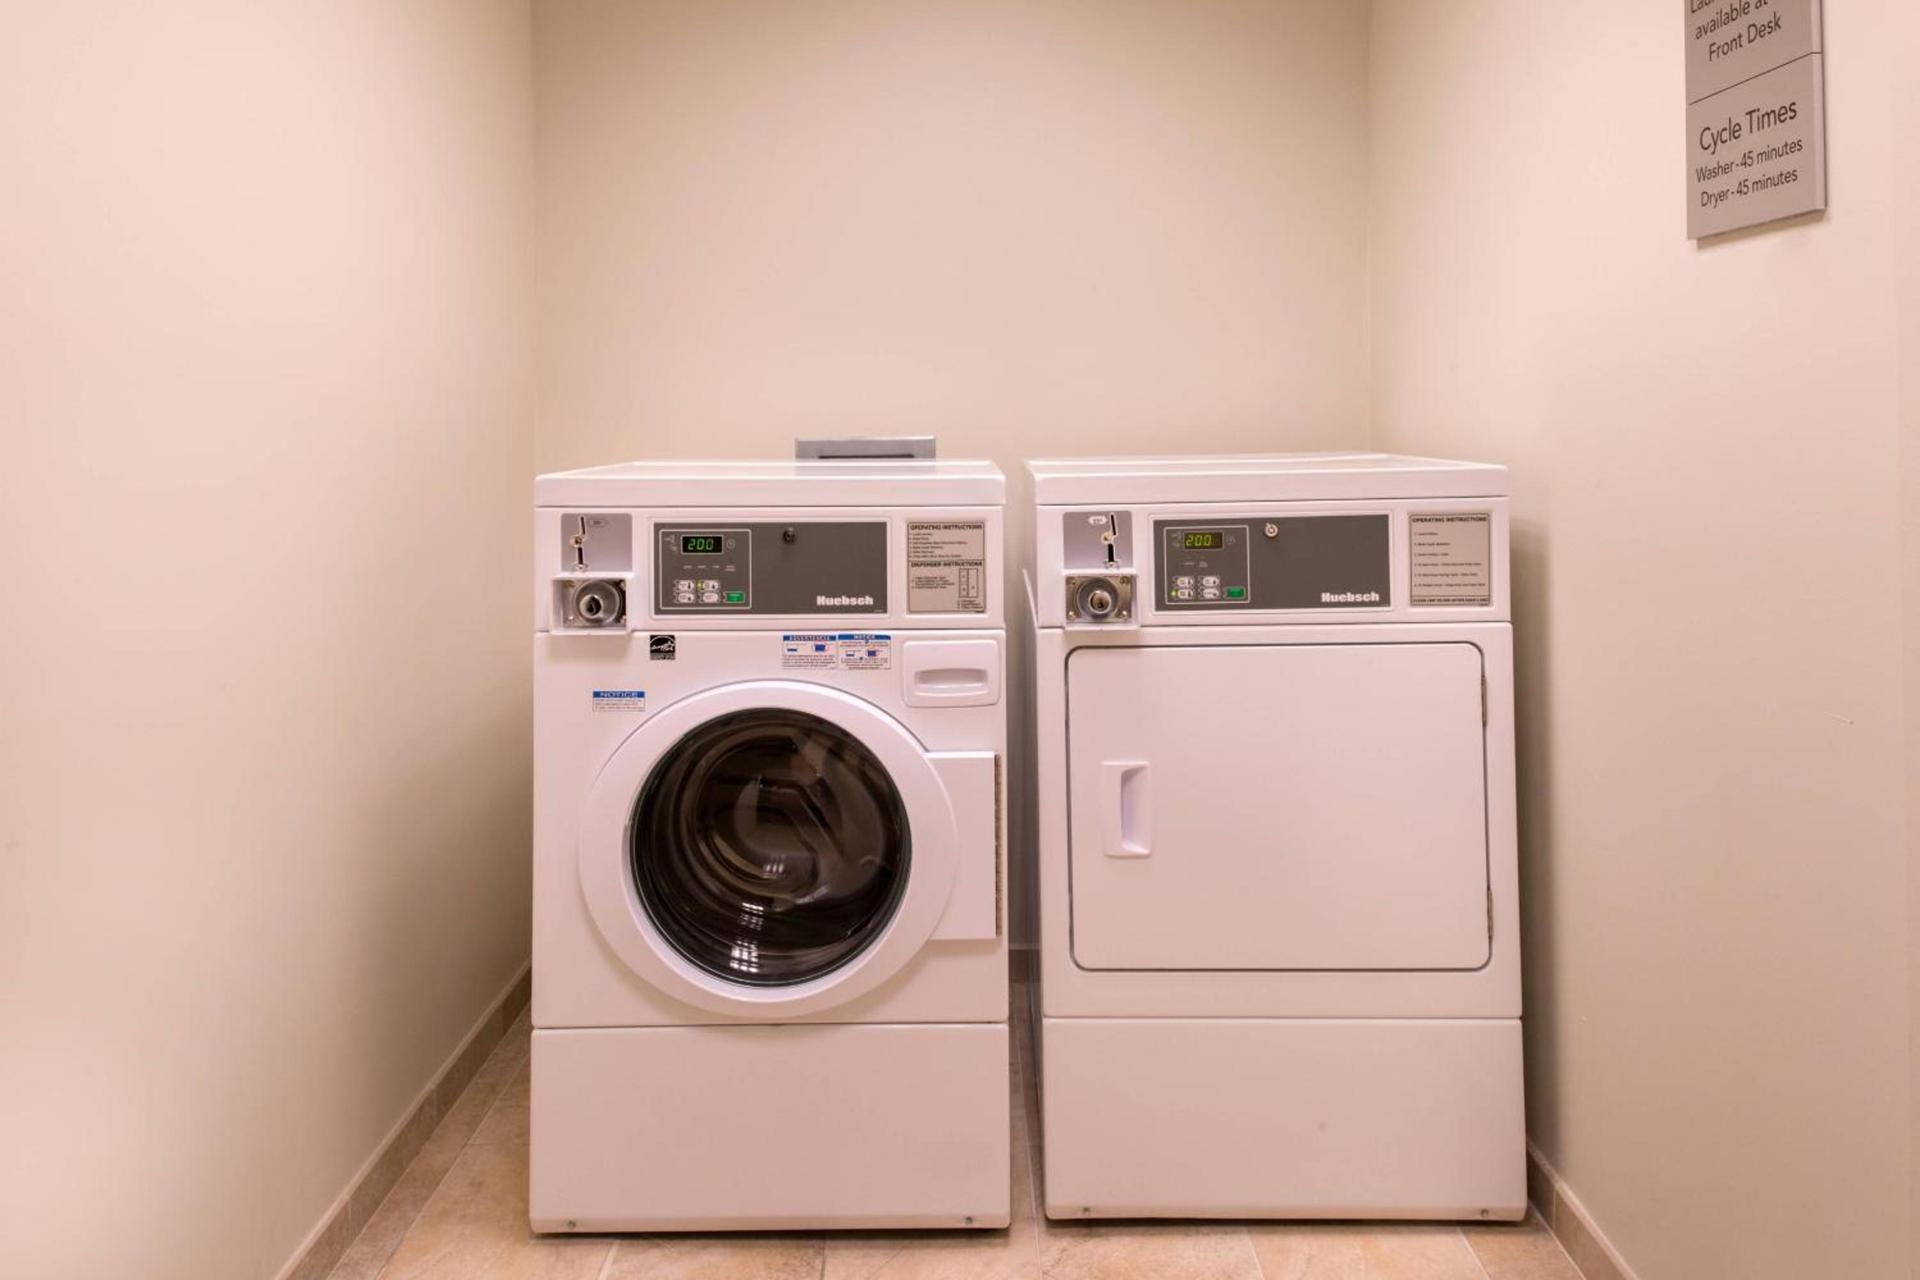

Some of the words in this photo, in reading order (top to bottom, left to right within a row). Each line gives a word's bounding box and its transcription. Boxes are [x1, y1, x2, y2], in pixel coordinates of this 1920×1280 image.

[1695, 0, 1750, 39] available
[1709, 32, 1743, 61] Front
[1747, 11, 1781, 44] Desk
[1700, 116, 1742, 155] Cycle
[1745, 102, 1797, 134] Times
[1756, 139, 1803, 164] minutes
[1752, 169, 1798, 192] minutes
[687, 538, 714, 550] 200
[1185, 534, 1212, 547] 200
[816, 595, 874, 606] Huebsch
[1321, 591, 1380, 603] Huebsch
